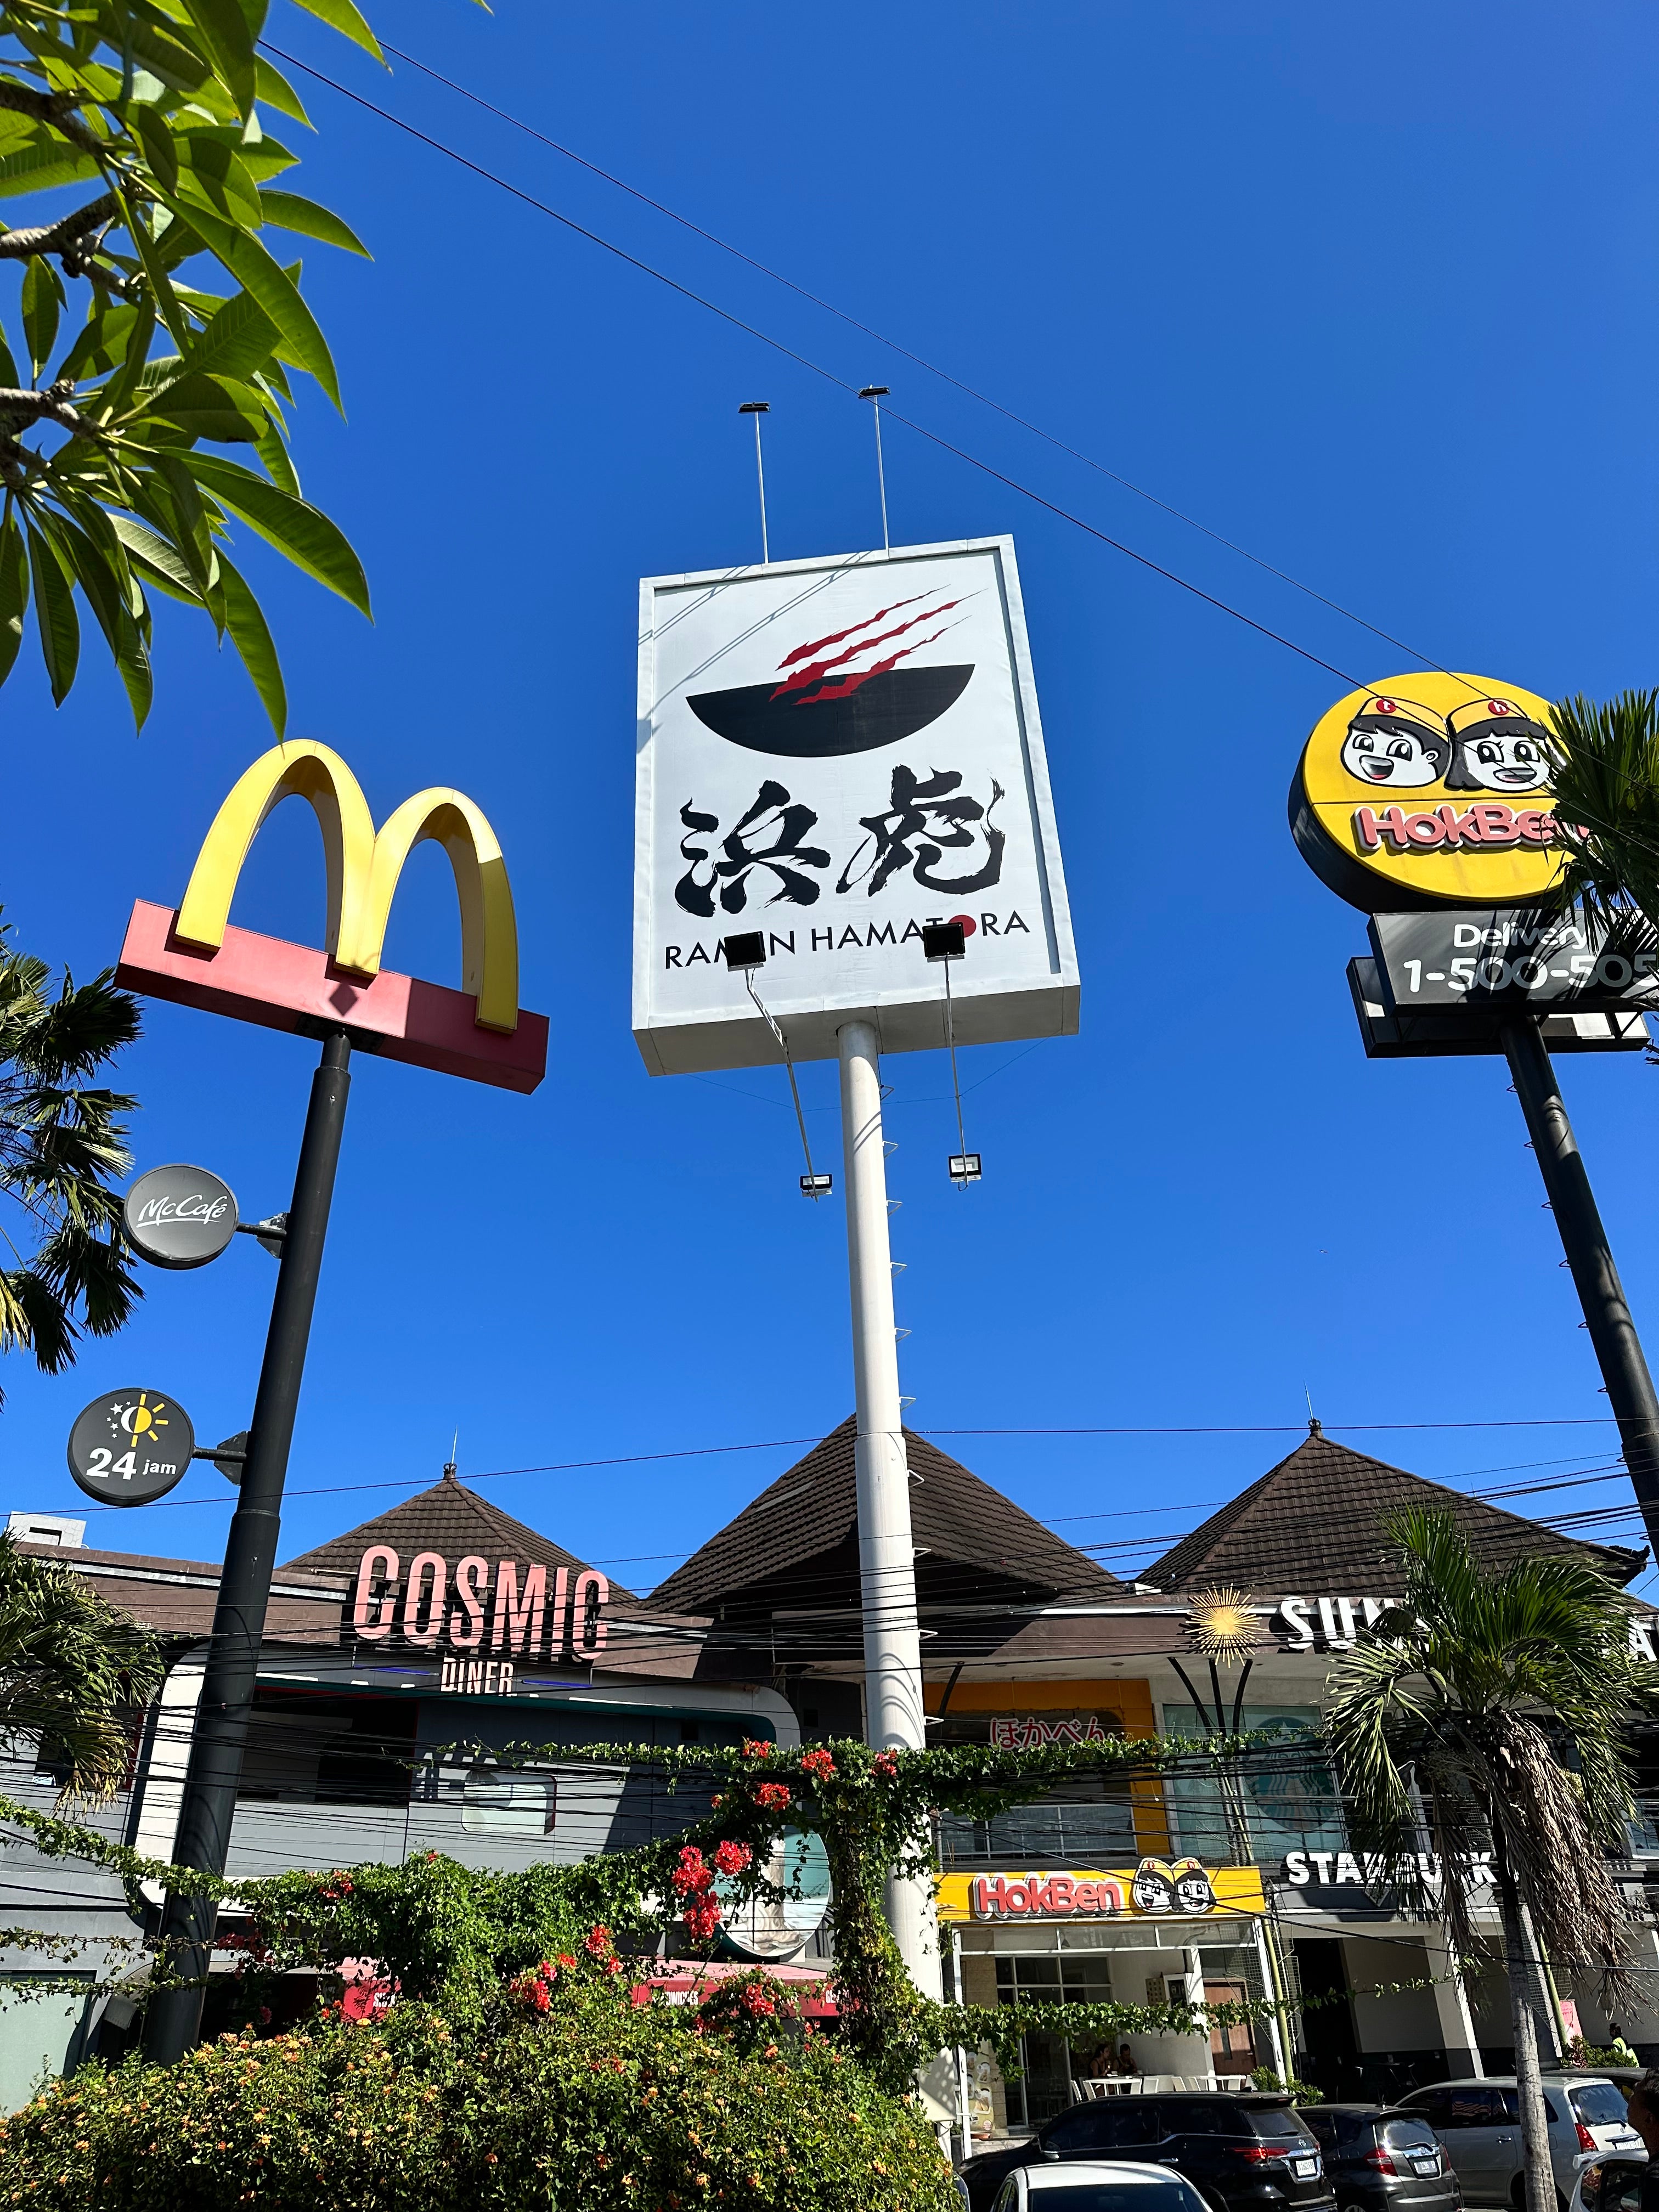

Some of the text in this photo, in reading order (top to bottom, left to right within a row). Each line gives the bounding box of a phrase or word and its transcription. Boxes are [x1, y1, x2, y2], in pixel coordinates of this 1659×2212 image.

[674, 764, 1006, 917] 浜虎
[1355, 804, 1590, 848] HokBe
[665, 930, 795, 969] RAN
[1454, 922, 1589, 950] Delivery
[137, 1194, 228, 1226] McCafé
[86, 1448, 176, 1480] 24 jam
[353, 1545, 609, 1660] COSMIC
[441, 1657, 516, 1697] DINER
[976, 1875, 1122, 1915] HokBen
